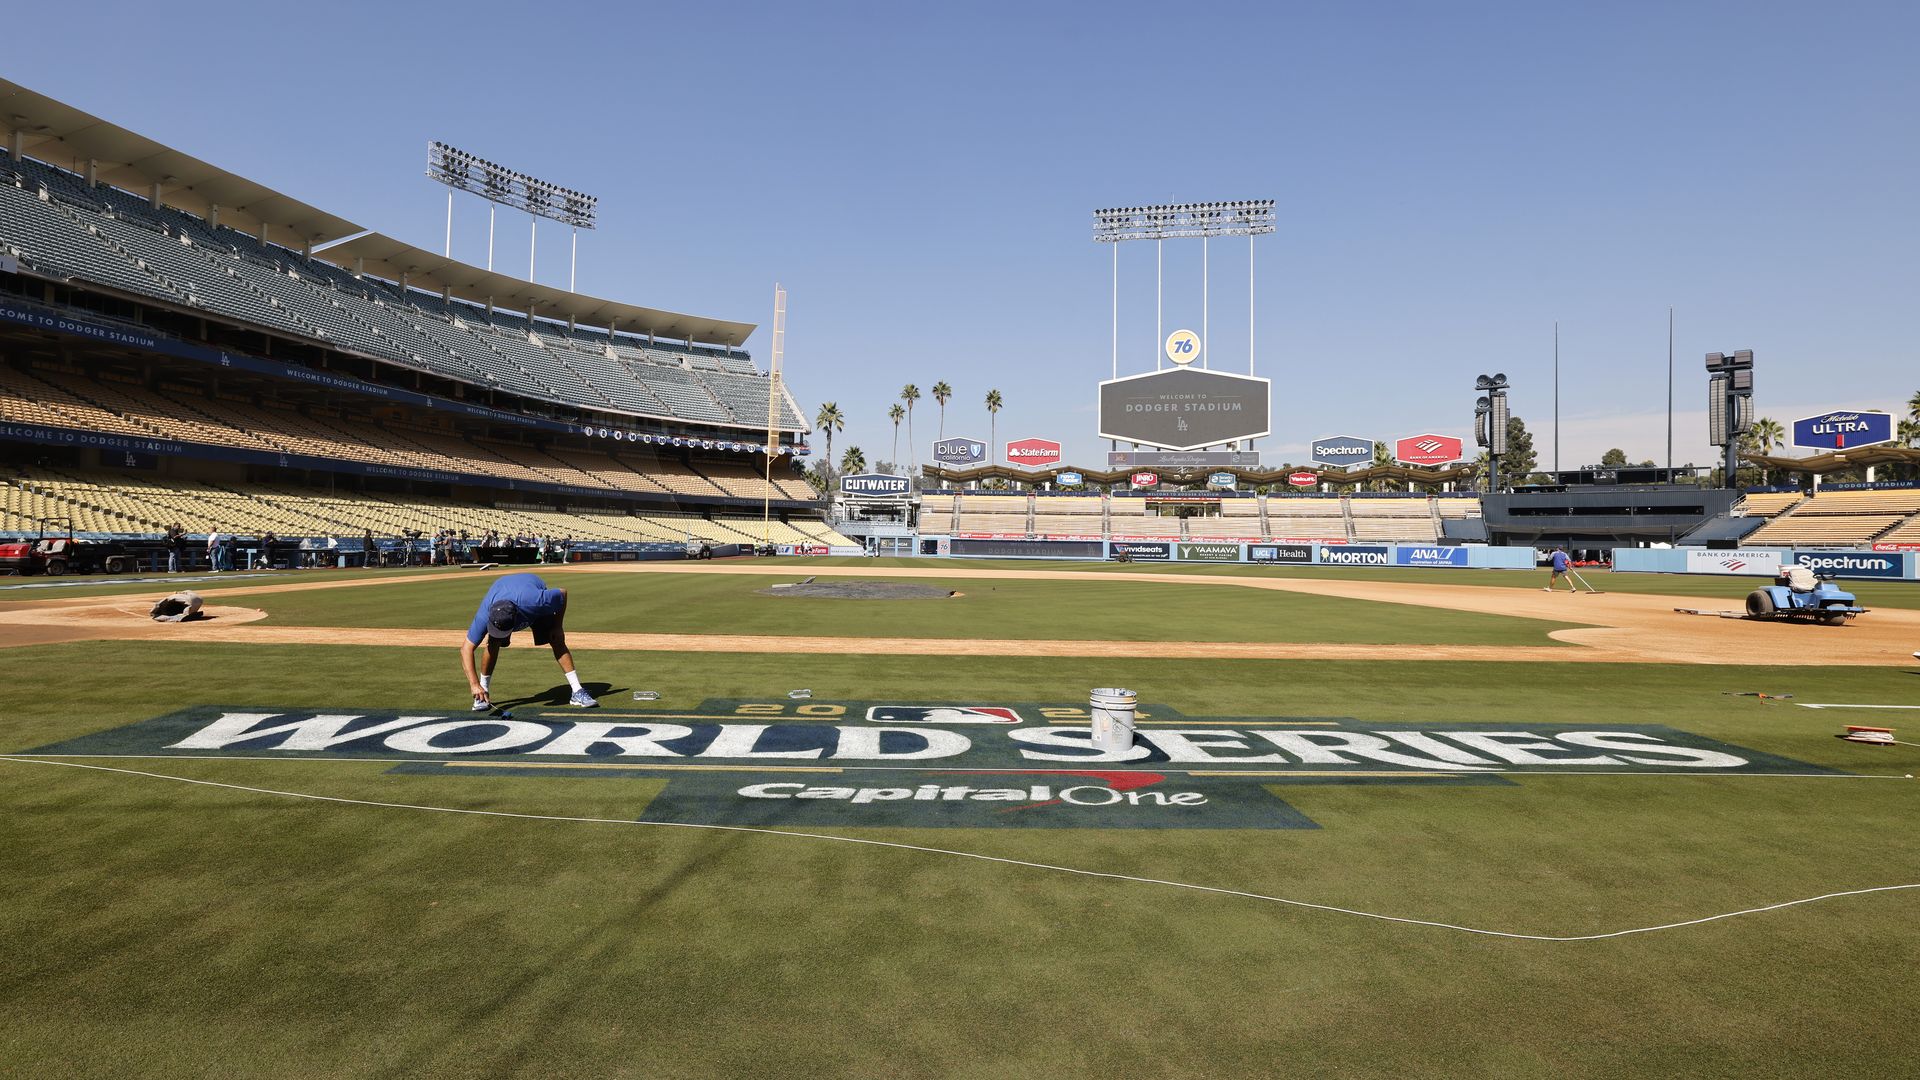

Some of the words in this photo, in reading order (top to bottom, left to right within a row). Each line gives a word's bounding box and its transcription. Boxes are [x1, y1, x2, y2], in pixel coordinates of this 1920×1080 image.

[39, 316, 54, 326] TO
[59, 321, 105, 337] DODGER
[109, 332, 154, 347] STADIUM
[1173, 339, 1193, 353] 76
[287, 369, 320, 382] WELCOME
[322, 376, 332, 384] TO
[333, 379, 360, 390] DODGER
[362, 385, 388, 396] STADIUM
[1126, 404, 1178, 412] DODGER
[1184, 402, 1242, 411] STADIUM
[1812, 422, 1869, 435] ULTRA
[59, 432, 74, 442] TO
[80, 435, 129, 448] DODGER
[134, 441, 182, 453] STADIUM
[938, 439, 967, 455] blue
[1316, 446, 1365, 456] Spectrum
[845, 479, 907, 491] CUTWATER
[1136, 475, 1154, 483] JINRO
[1279, 549, 1307, 558] Health
[1330, 552, 1387, 564] MORTON
[1411, 549, 1437, 559] ANA
[1799, 555, 1887, 571] Spectrum
[163, 713, 972, 761] WORLD
[1007, 726, 1749, 770] SERIES
